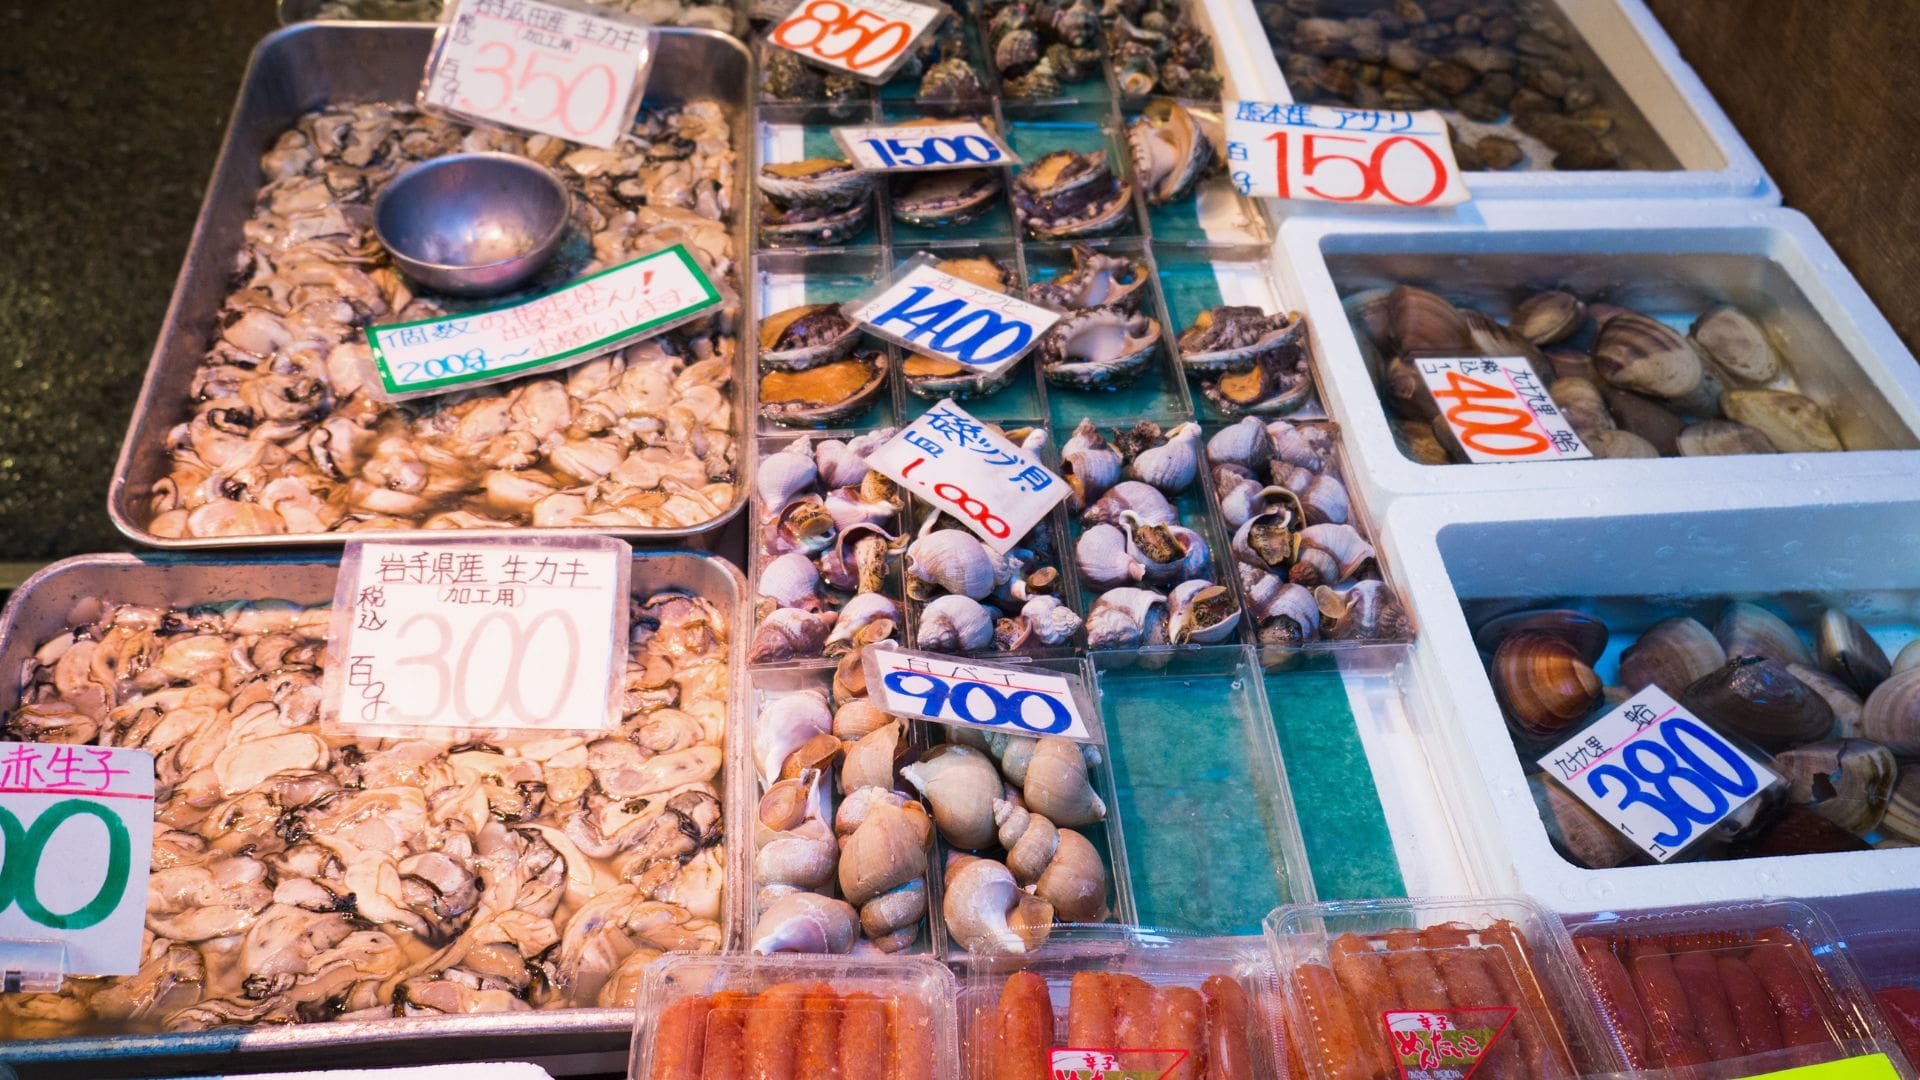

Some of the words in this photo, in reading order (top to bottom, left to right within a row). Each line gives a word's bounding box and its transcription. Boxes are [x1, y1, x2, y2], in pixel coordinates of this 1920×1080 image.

[774, 0, 911, 70] 850
[459, 40, 617, 136] 350
[858, 135, 1001, 167] 1500
[1332, 108, 1413, 132] アサリ
[1264, 132, 1448, 206] 150
[871, 286, 1033, 365] 1400
[1432, 370, 1550, 456] 400
[376, 552, 488, 585] 岩手県産
[498, 554, 590, 587] 生カキ
[356, 585, 388, 631] 税込
[386, 608, 581, 726] 300
[884, 671, 1072, 734] 900
[0, 744, 130, 791] 赤生子
[1554, 735, 1613, 779] 九十九里
[1587, 717, 1759, 847] 380
[0, 798, 131, 930] 0
[1417, 1014, 1447, 1031] 辛子
[1083, 1053, 1116, 1072] 辛子
